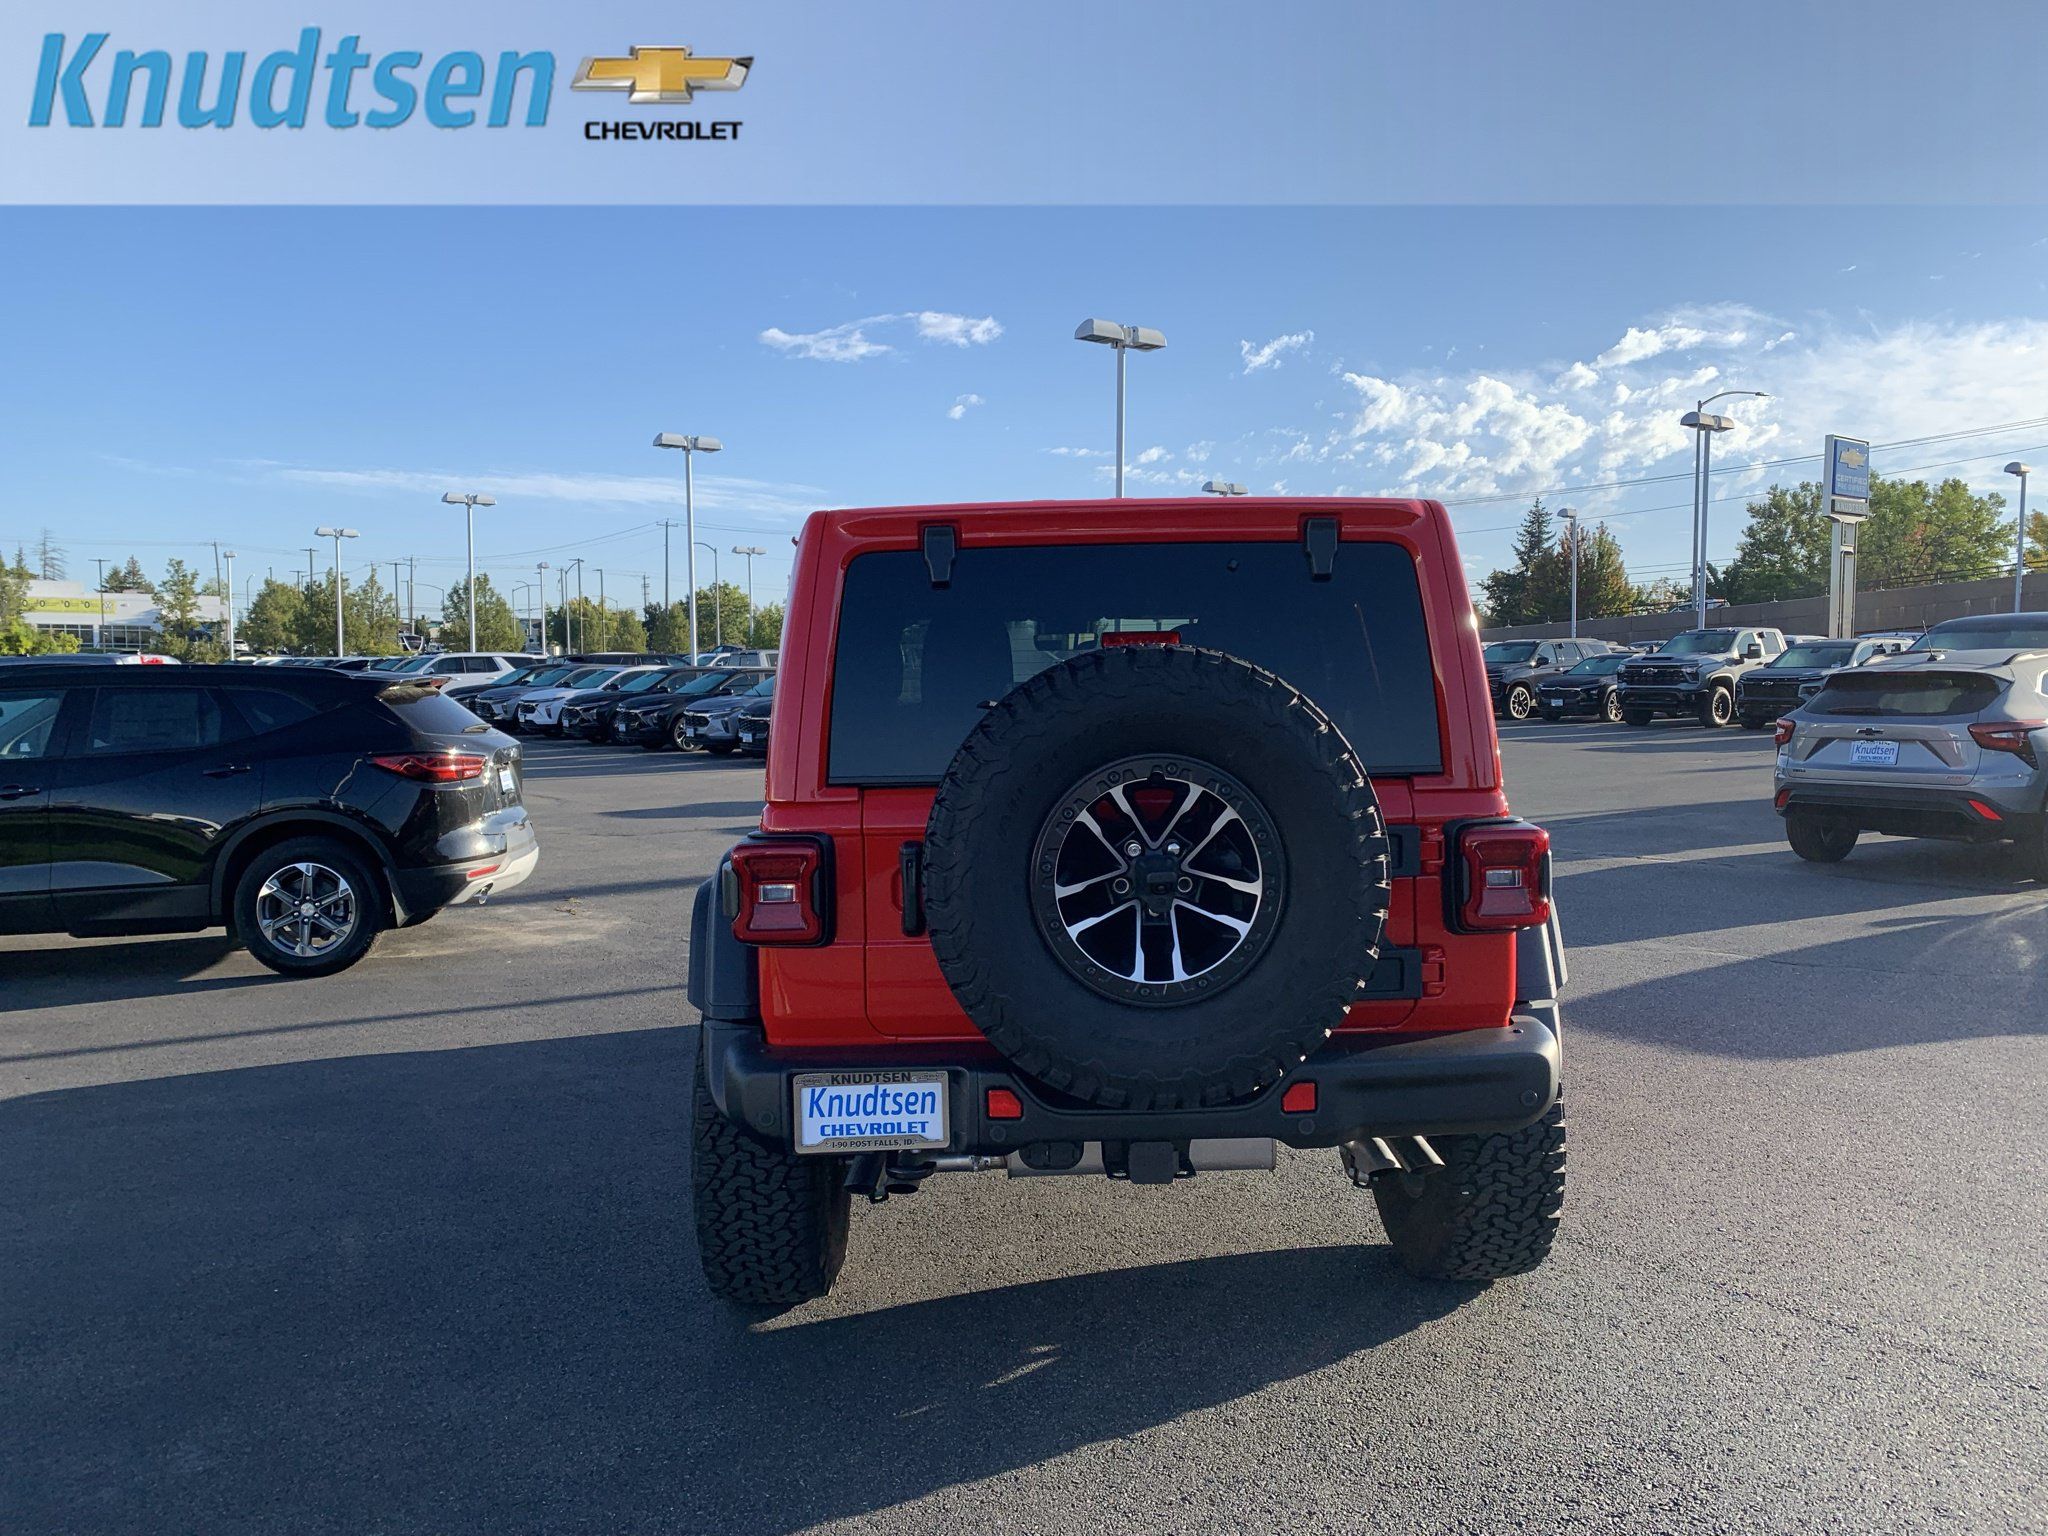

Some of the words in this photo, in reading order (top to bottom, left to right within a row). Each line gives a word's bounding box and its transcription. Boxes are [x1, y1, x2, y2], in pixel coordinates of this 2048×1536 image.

[1855, 744, 1895, 756] Knudtsen
[831, 1072, 912, 1085] KNUDTSEN
[808, 1085, 936, 1118] Knudtsen
[820, 1121, 929, 1137] CHEVROLET
[850, 1140, 872, 1148] POST
[874, 1139, 901, 1148] FALLS,
